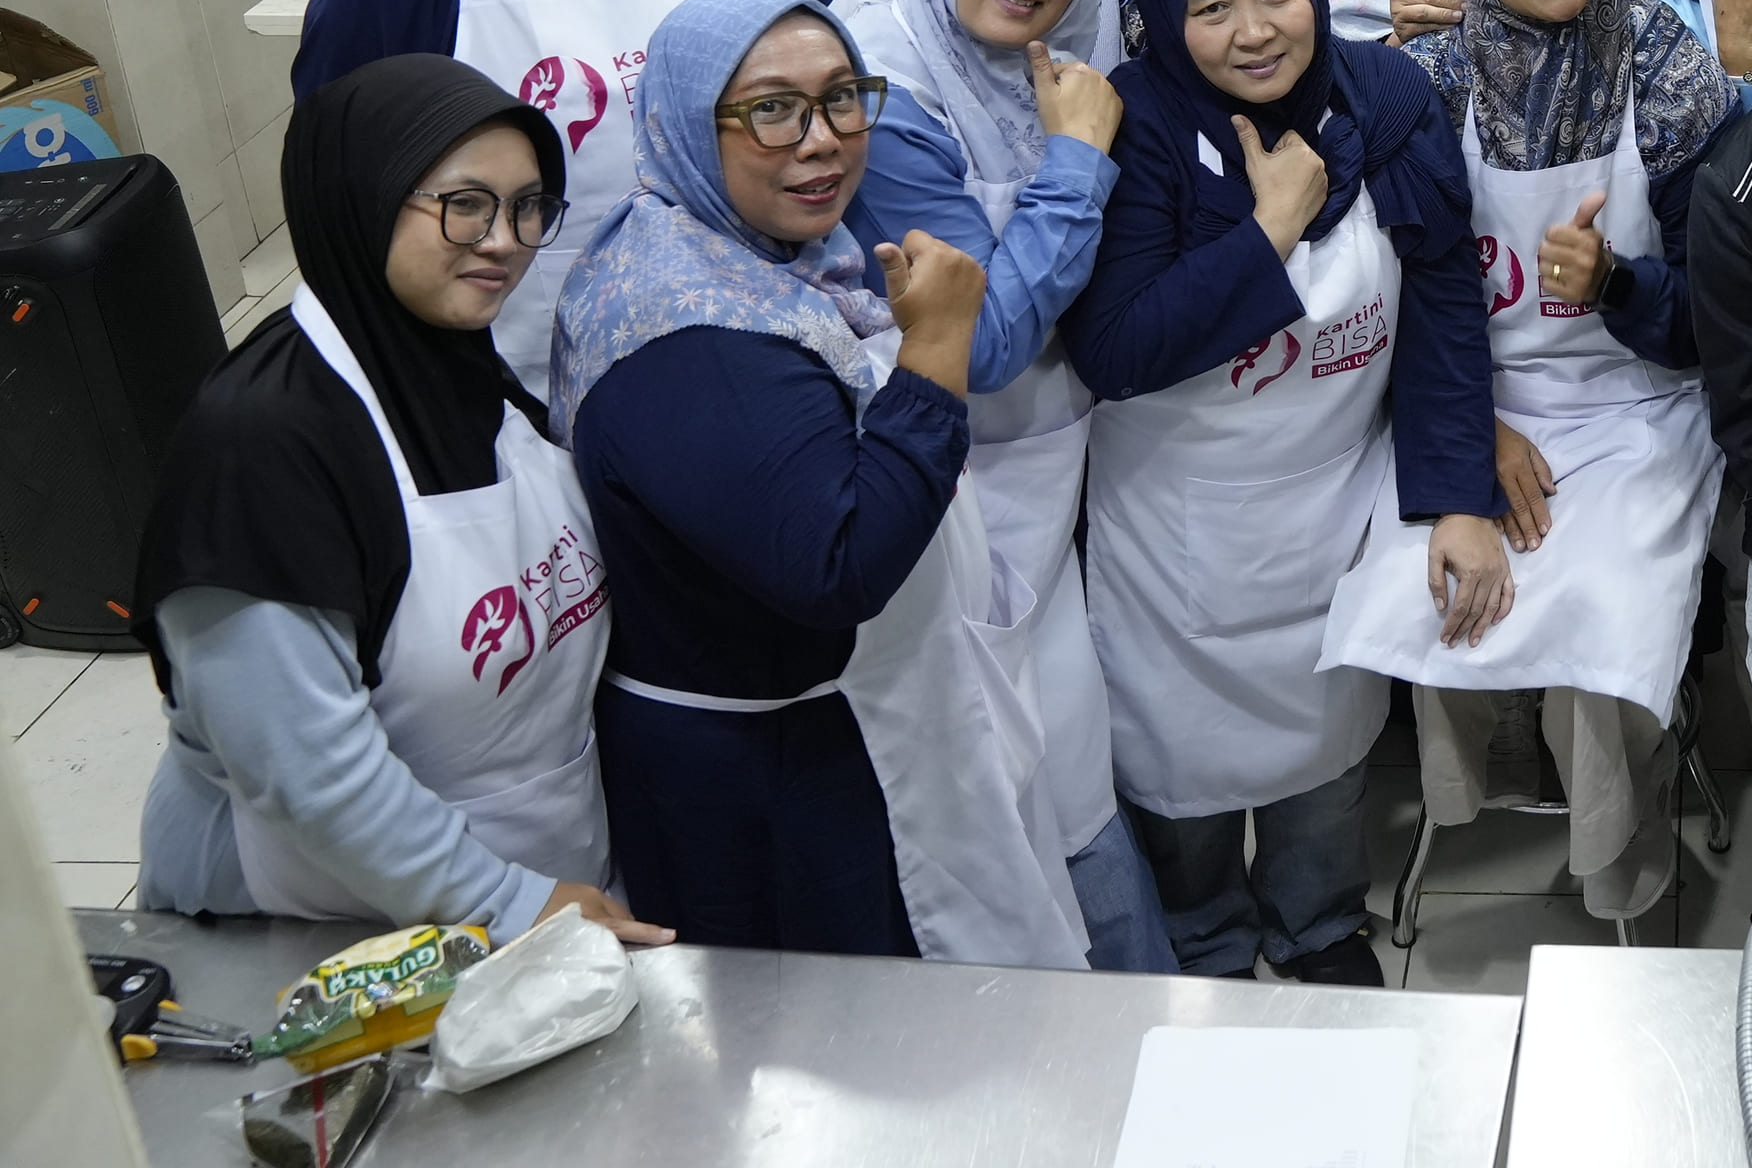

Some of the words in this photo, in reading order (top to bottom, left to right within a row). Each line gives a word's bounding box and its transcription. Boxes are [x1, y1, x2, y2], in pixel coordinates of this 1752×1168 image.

[1317, 292, 1383, 340] Kartini
[1546, 304, 1580, 315] Bikin
[1312, 315, 1387, 361] BISA
[1317, 361, 1351, 376] Bikin
